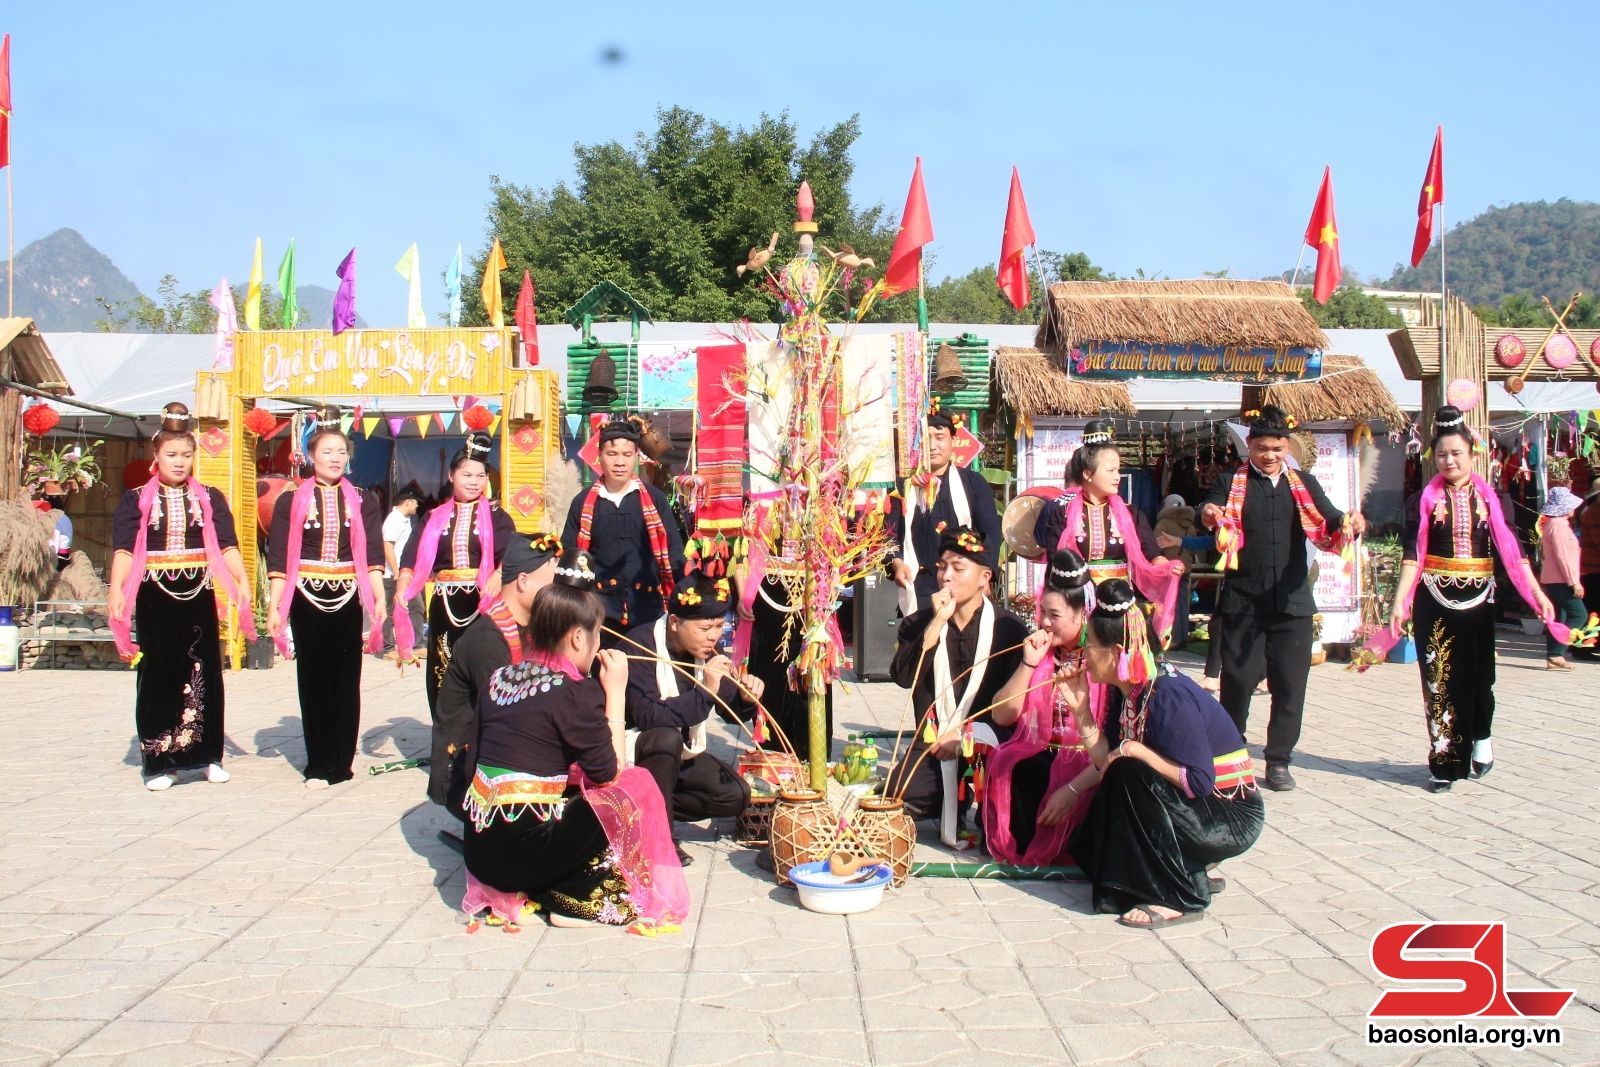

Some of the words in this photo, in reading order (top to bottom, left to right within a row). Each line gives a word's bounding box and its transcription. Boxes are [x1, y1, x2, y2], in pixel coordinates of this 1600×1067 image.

[263, 344, 302, 393] Quê
[310, 339, 339, 372] Em
[346, 332, 378, 369] Ven
[1147, 346, 1173, 371] trên
[1197, 353, 1218, 372] cao
